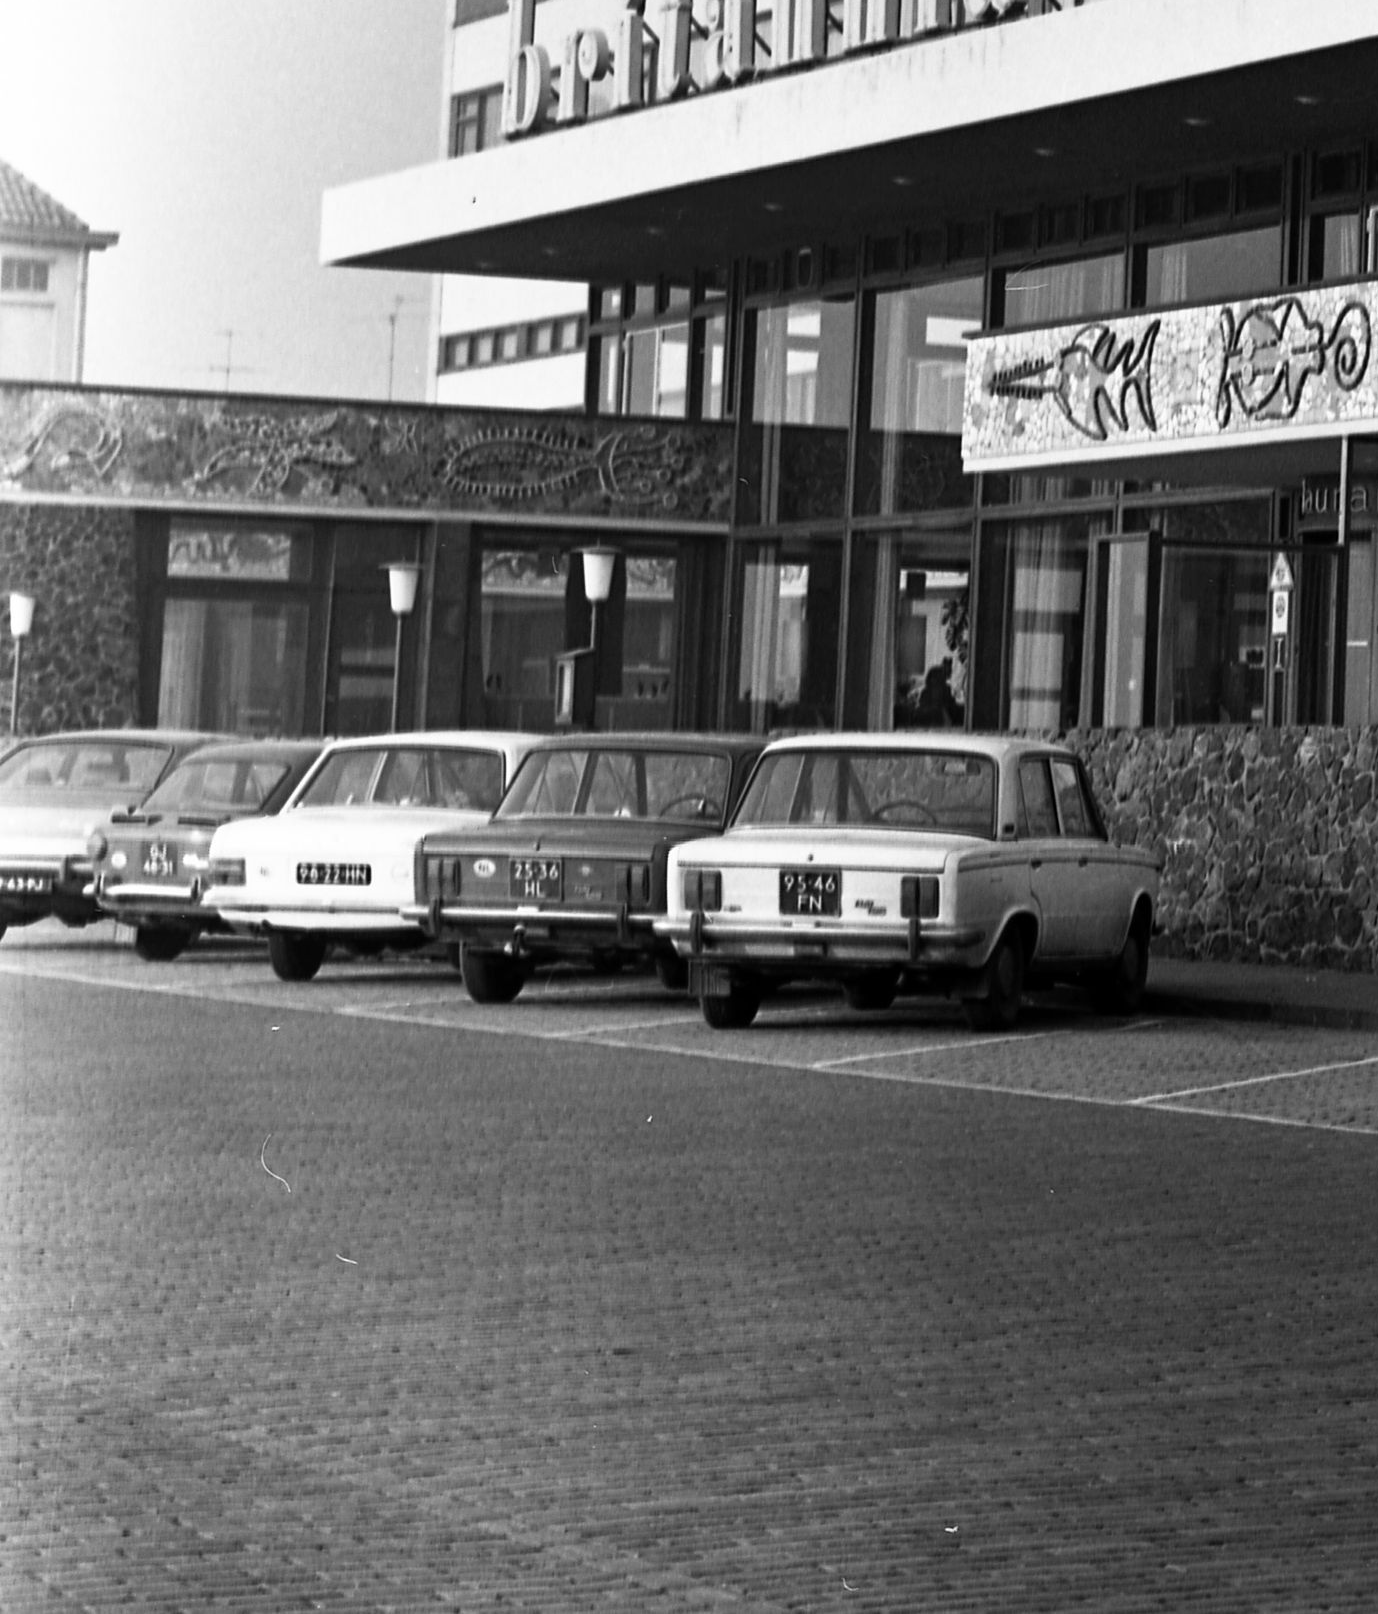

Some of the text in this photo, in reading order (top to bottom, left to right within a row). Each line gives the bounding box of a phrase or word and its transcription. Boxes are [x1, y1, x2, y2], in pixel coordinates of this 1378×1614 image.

[524, 880, 546, 898] HL
[784, 875, 836, 893] 95-46
[797, 894, 823, 913] FN
